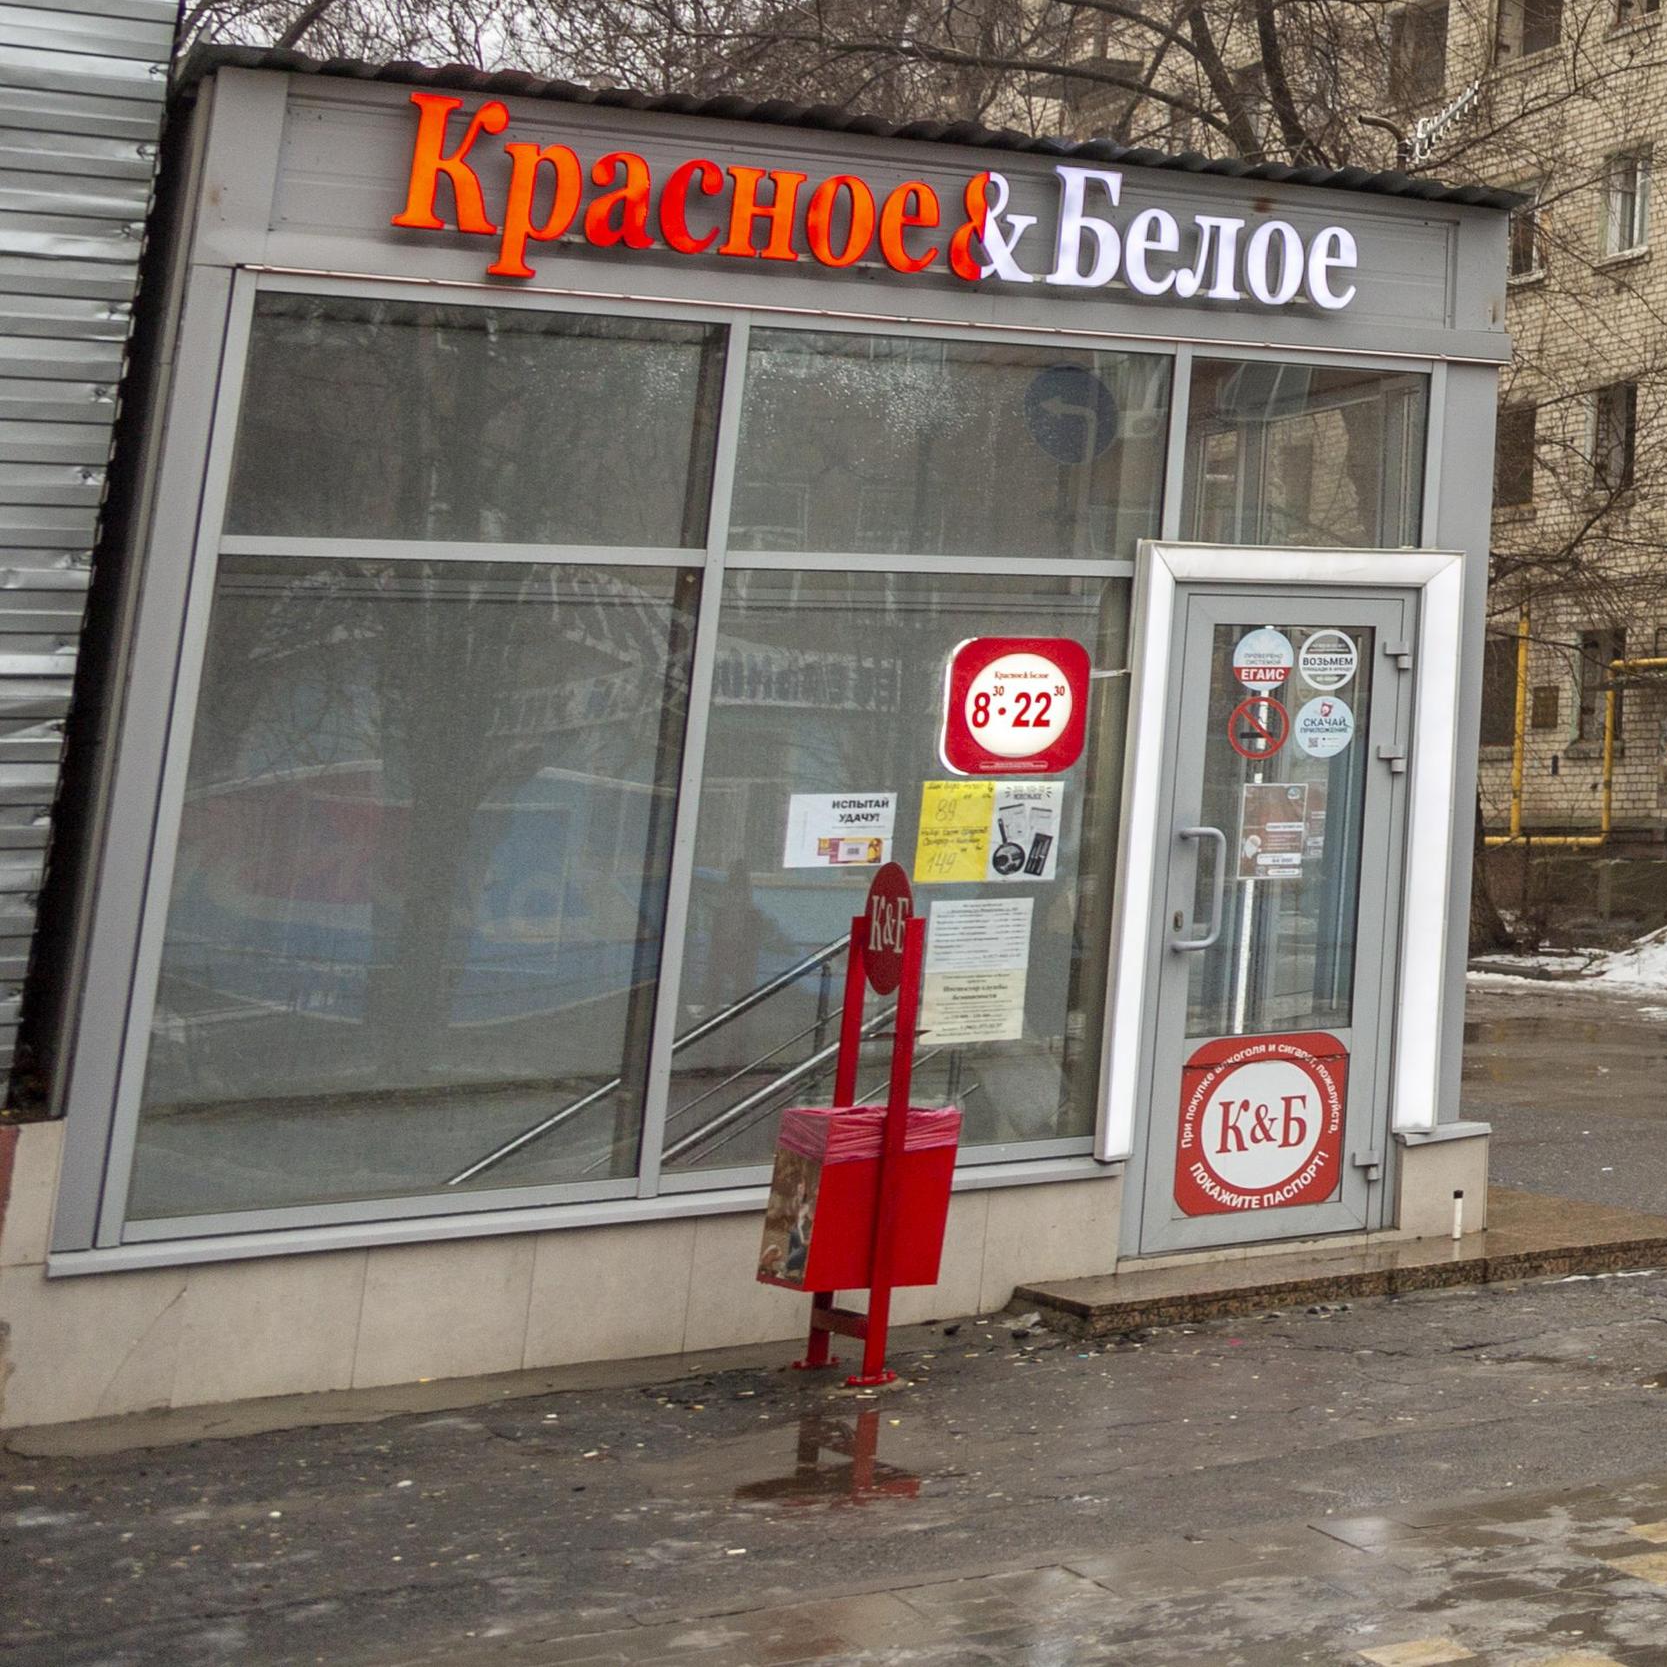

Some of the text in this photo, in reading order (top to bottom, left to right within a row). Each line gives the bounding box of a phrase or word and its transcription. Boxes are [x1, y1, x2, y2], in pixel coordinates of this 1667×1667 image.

[1302, 657, 1353, 666] ВОЗЬМЕМ
[1241, 669, 1285, 680] ЕГАИС
[971, 686, 1066, 728] 8 30 22 30
[1303, 717, 1347, 727] СКАЧАЙ
[832, 798, 889, 809] ИСПЫТАЙ
[839, 813, 880, 822] УДАЧУ!
[1268, 1044, 1276, 1053] и
[1186, 1073, 1215, 1121] покупке
[1215, 1095, 1308, 1154] К&Б
[1181, 1125, 1194, 1148] При
[1189, 1150, 1330, 1209] ПОКАЖИТЕ ПАСПОРТ!
